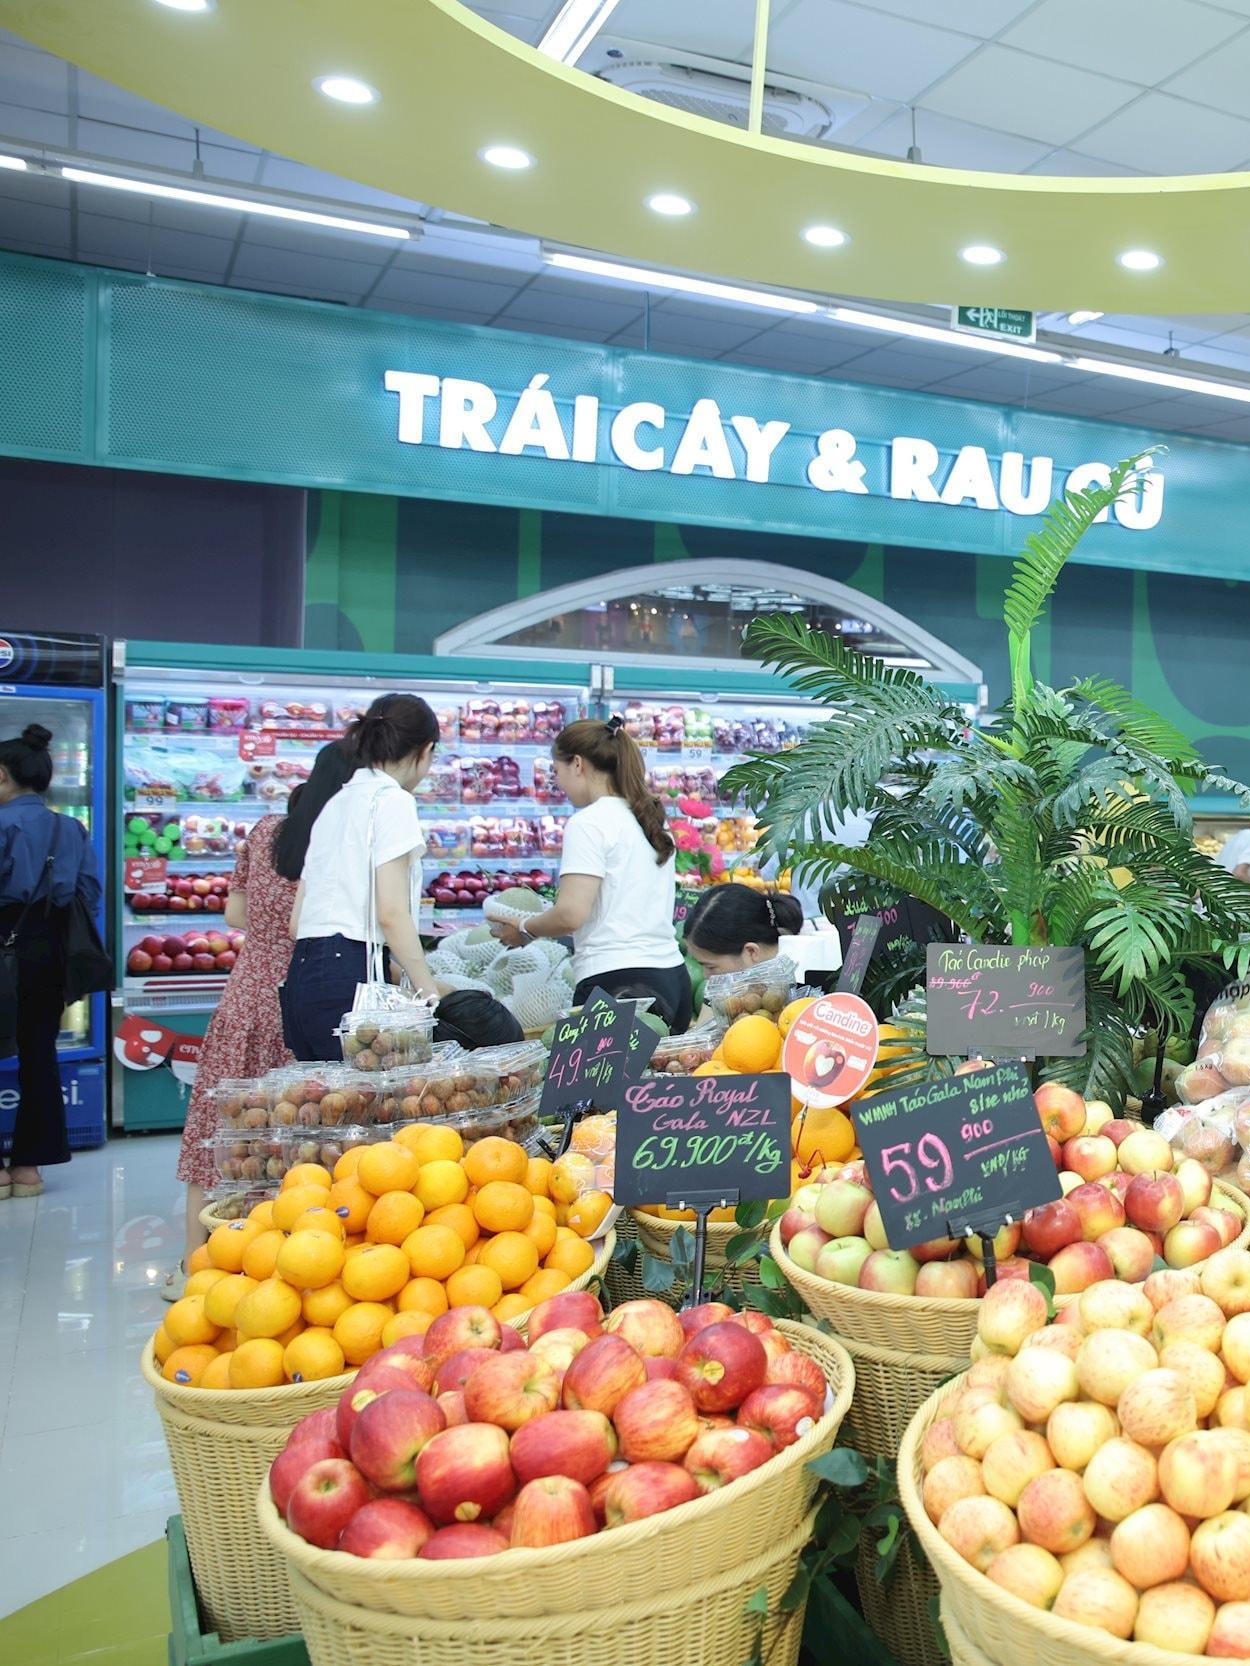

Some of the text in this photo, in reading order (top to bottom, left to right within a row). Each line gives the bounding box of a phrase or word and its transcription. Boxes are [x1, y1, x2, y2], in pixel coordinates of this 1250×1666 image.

[1000, 323, 1023, 334] EXIT
[384, 370, 599, 462] TRÁI
[610, 398, 792, 484] CÂY
[808, 429, 869, 494] &
[889, 436, 1053, 515] RAU
[1027, 982, 1055, 998] 900
[815, 1002, 870, 1036] Candine
[625, 1077, 760, 1116] Táo Royal
[926, 1084, 962, 1105] Gala
[963, 1073, 995, 1095] Nam
[652, 1108, 777, 1131] Gala NZL
[960, 1119, 994, 1143] 900
[880, 1132, 954, 1203] 59
